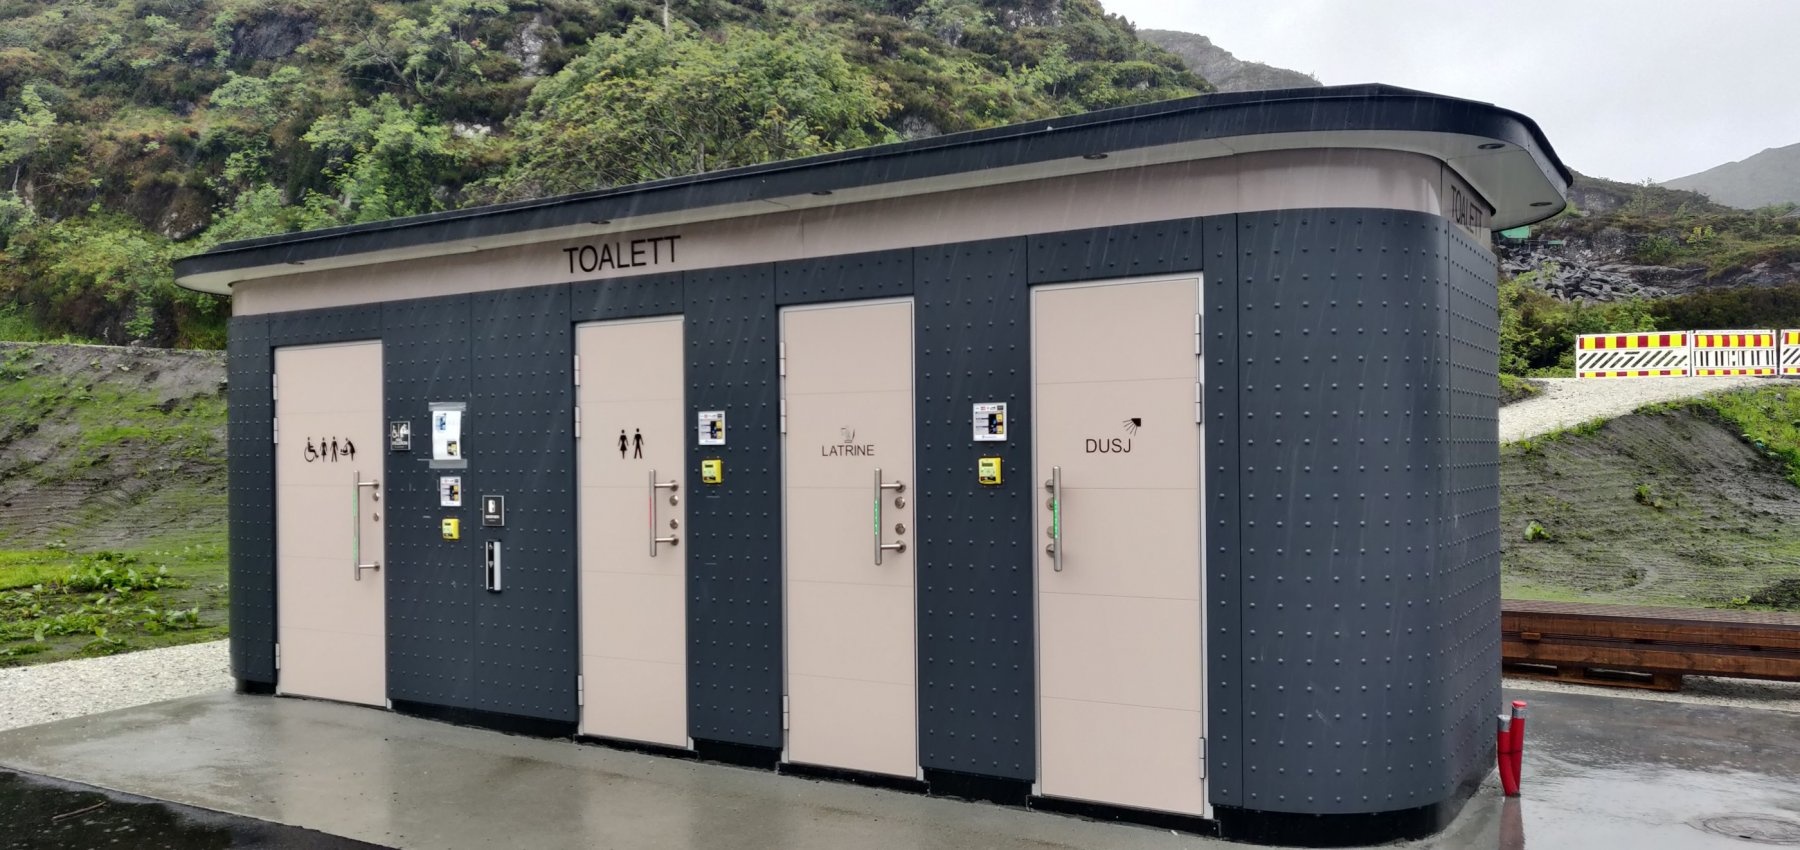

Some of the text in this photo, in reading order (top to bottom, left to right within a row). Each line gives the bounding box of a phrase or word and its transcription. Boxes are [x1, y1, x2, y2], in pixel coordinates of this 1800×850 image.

[1451, 184, 1482, 239] TOALETT
[563, 235, 681, 273] TOALETT
[821, 444, 875, 457] LATRINE
[1086, 438, 1131, 453] DUSJ
